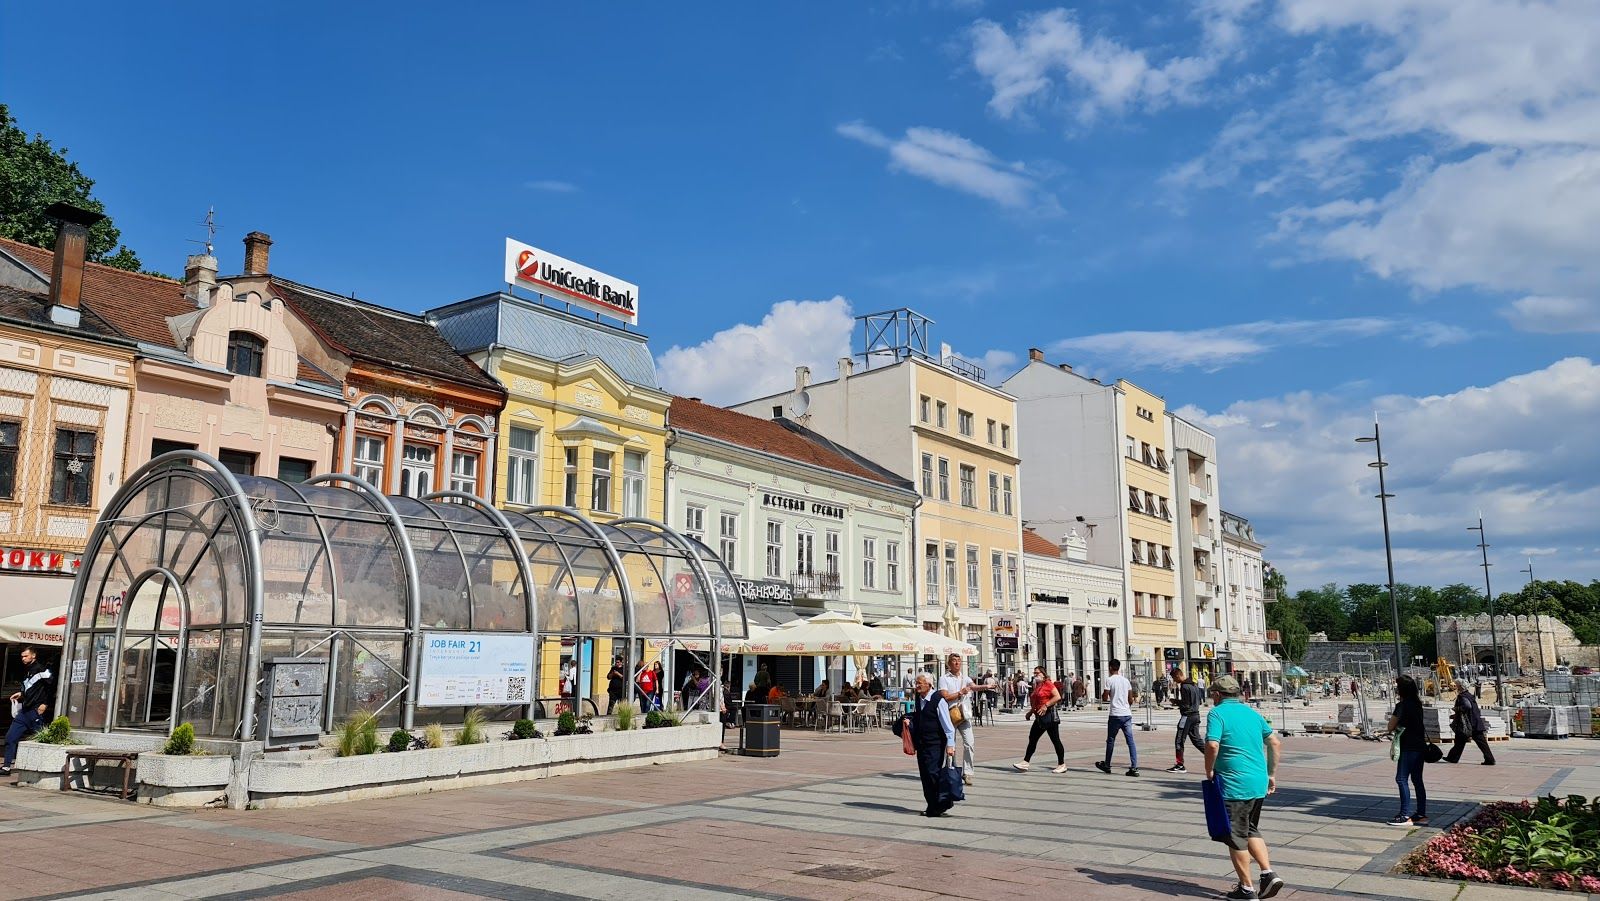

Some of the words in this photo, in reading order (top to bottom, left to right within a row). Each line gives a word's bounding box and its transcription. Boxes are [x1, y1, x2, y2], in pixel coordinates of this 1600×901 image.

[541, 262, 600, 298] UniCredit
[602, 284, 634, 310] Bank
[998, 618, 1011, 627] dm
[20, 631, 26, 639] TO
[27, 632, 33, 640] JE
[34, 632, 43, 640] TAJ
[45, 633, 64, 642] OSEĆA
[430, 640, 446, 648] JOB
[448, 640, 466, 649] FAIR
[469, 641, 481, 653] 21
